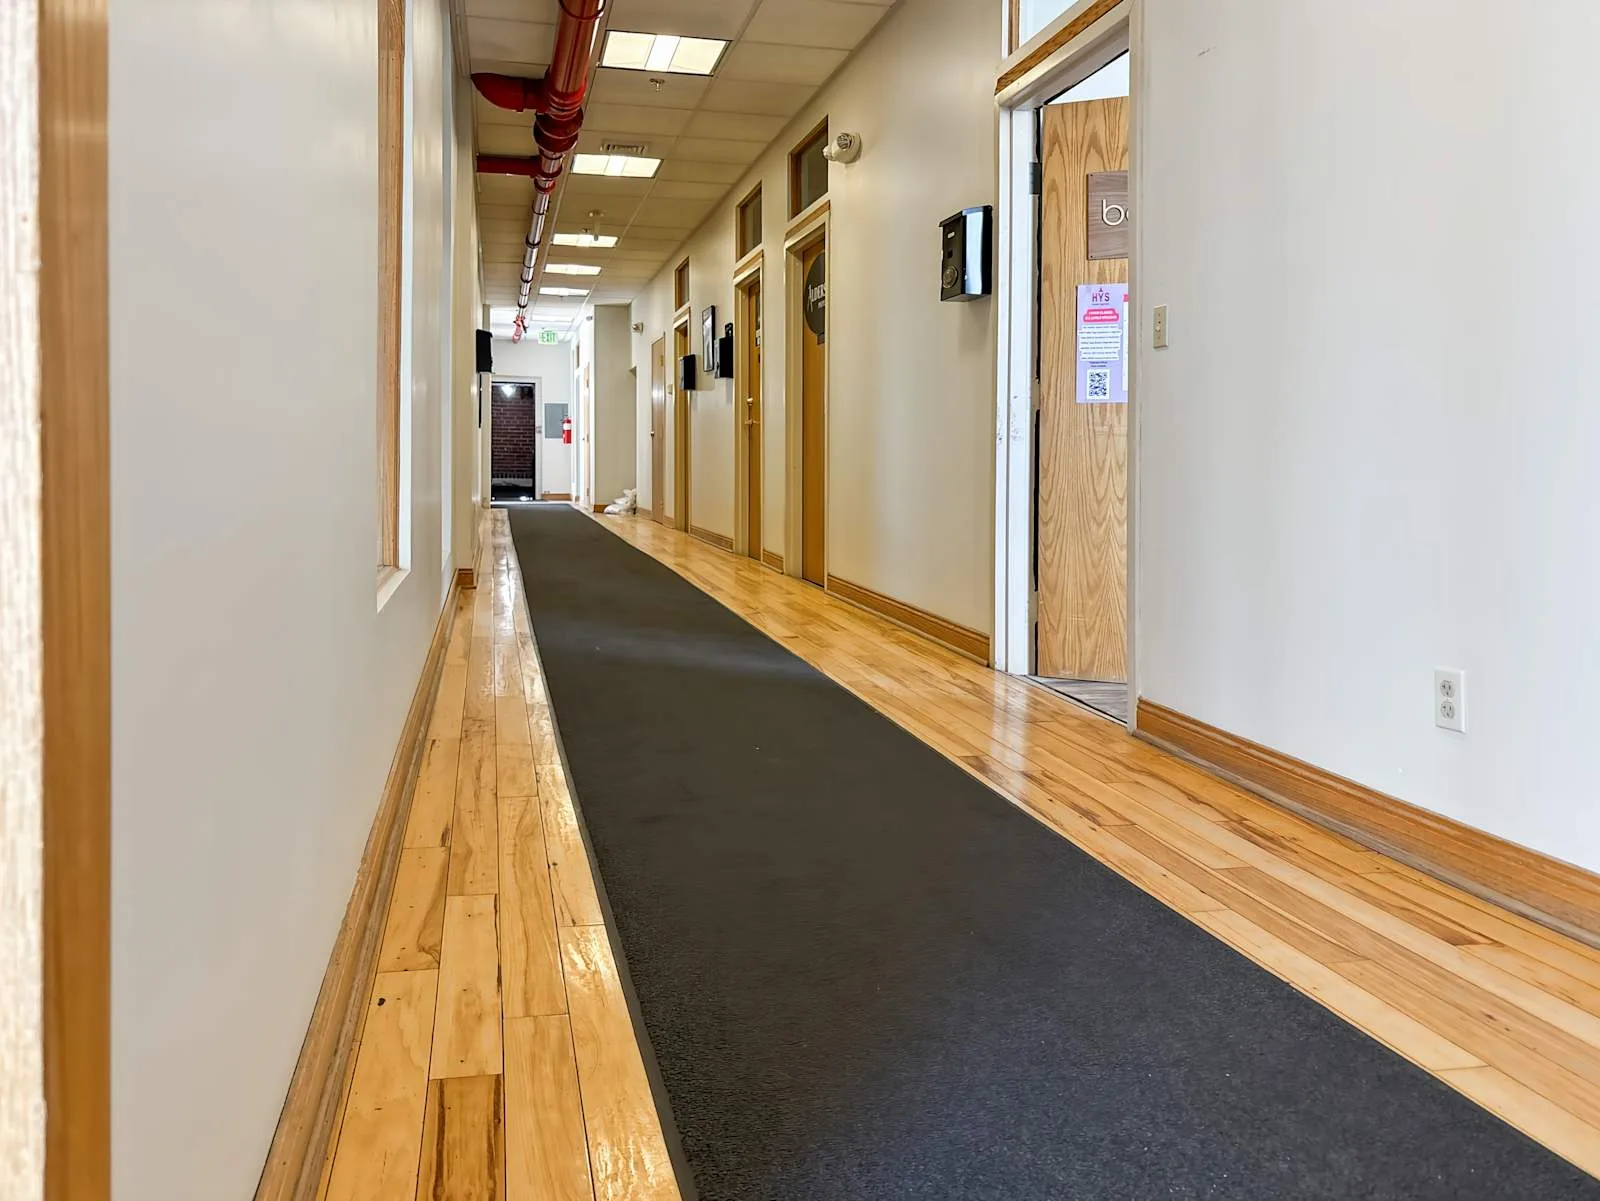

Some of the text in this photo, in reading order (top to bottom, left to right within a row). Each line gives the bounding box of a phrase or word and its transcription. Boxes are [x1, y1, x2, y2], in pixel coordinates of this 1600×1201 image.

[1101, 198, 1129, 226] b
[1092, 292, 1110, 302] HYS
[541, 332, 556, 343] EXIT
